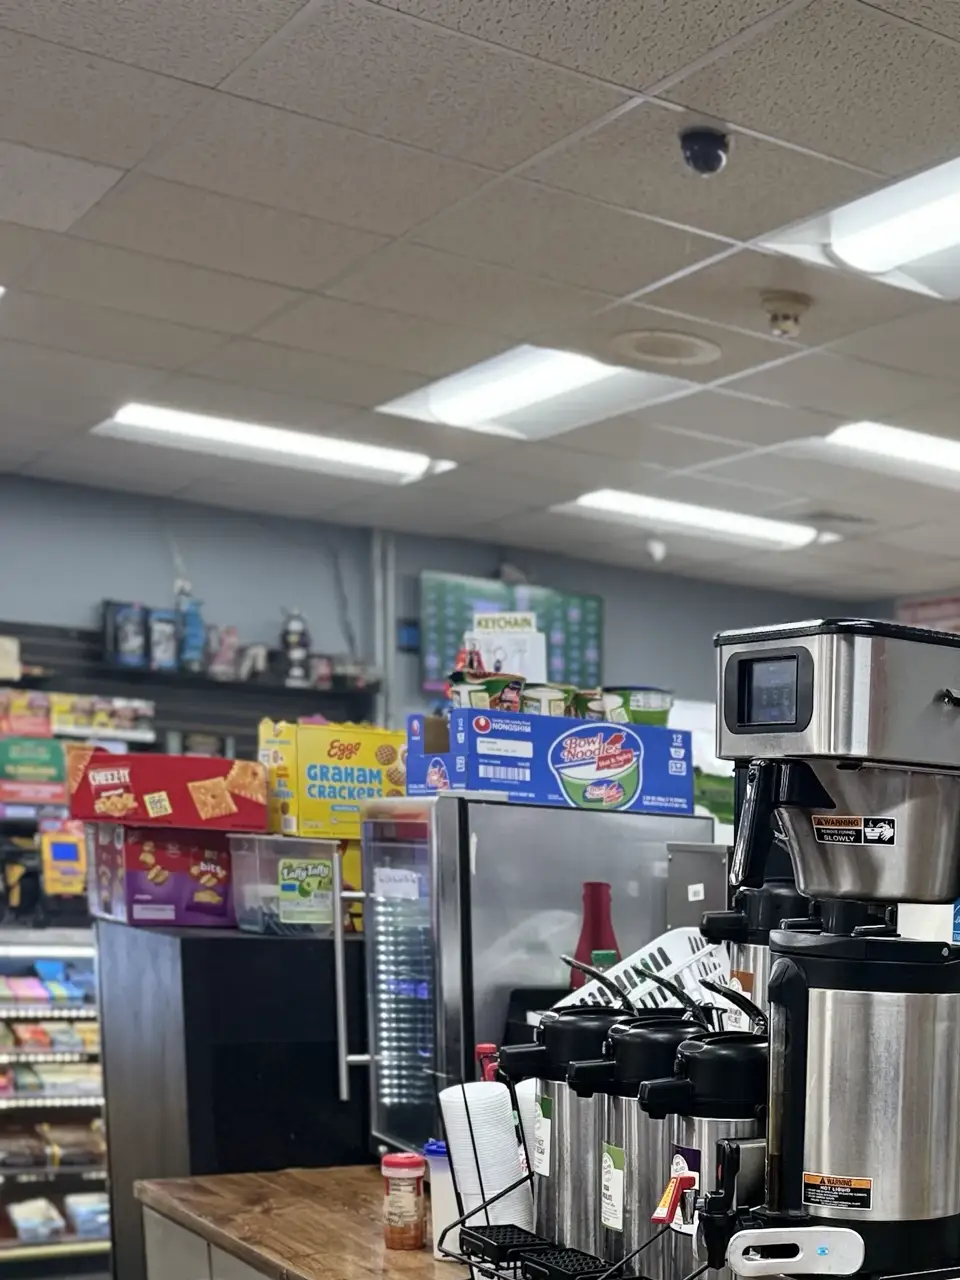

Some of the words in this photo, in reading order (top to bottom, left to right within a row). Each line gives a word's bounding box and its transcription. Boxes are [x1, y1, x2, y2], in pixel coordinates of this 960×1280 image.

[477, 615, 533, 630] KEYCHAIN
[492, 723, 531, 732] NONGSHIM
[563, 732, 603, 749] Bowl
[327, 739, 361, 760] Eggo
[561, 745, 621, 762] Noodles
[824, 819, 860, 827] WARNING
[282, 867, 307, 881] Laffy
[307, 863, 330, 877] Taffy
[826, 1178, 852, 1187] WARNING
